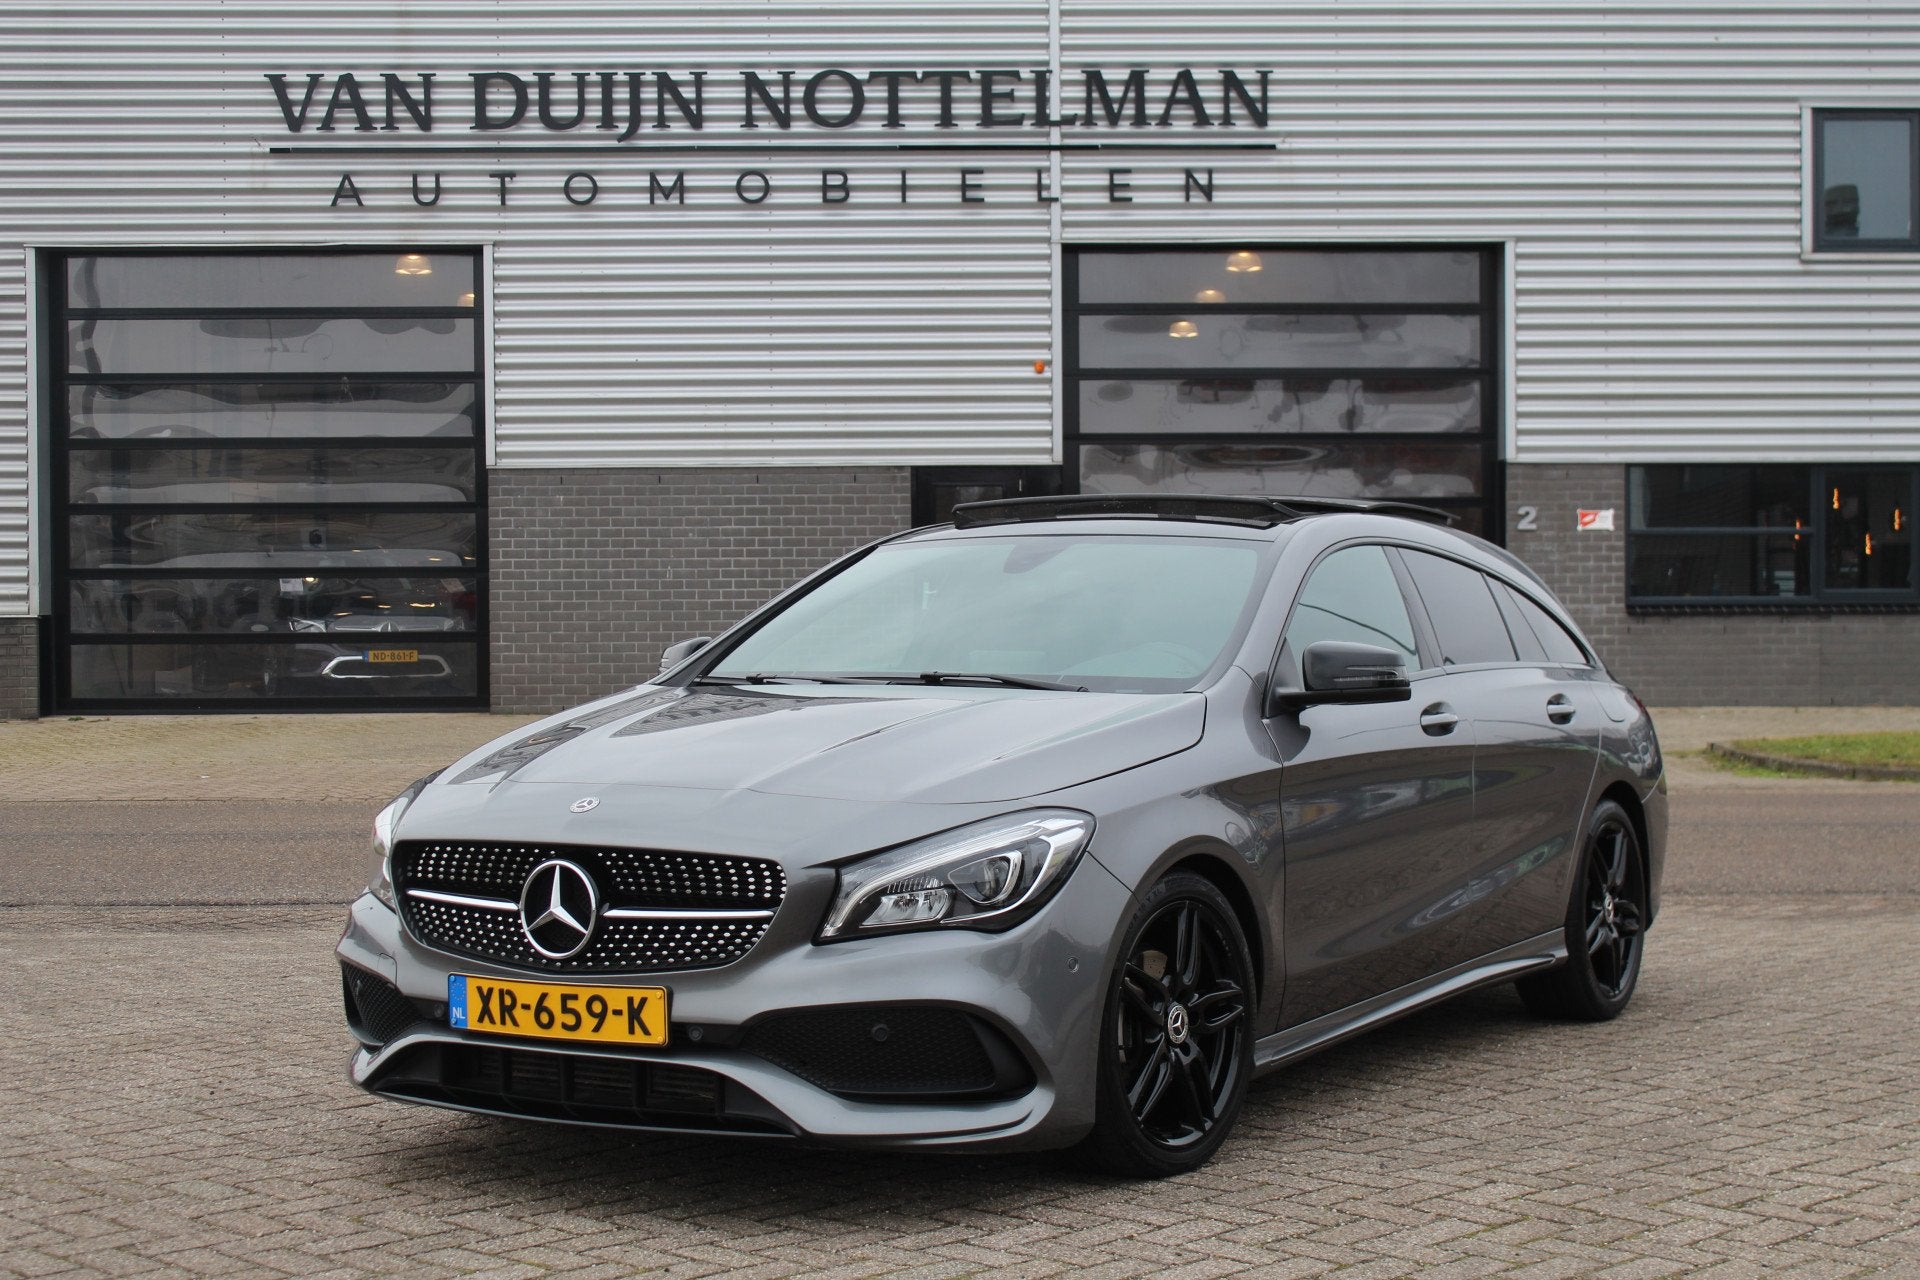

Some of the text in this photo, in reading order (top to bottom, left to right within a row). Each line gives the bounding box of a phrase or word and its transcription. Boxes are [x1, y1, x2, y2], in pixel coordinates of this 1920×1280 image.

[263, 68, 1274, 143] VAN DUIJN NOTTELMAN
[330, 168, 1214, 207] AUTOMOBIELEN
[1517, 505, 1538, 531] 2
[452, 985, 652, 1036] NL XR-659-K
